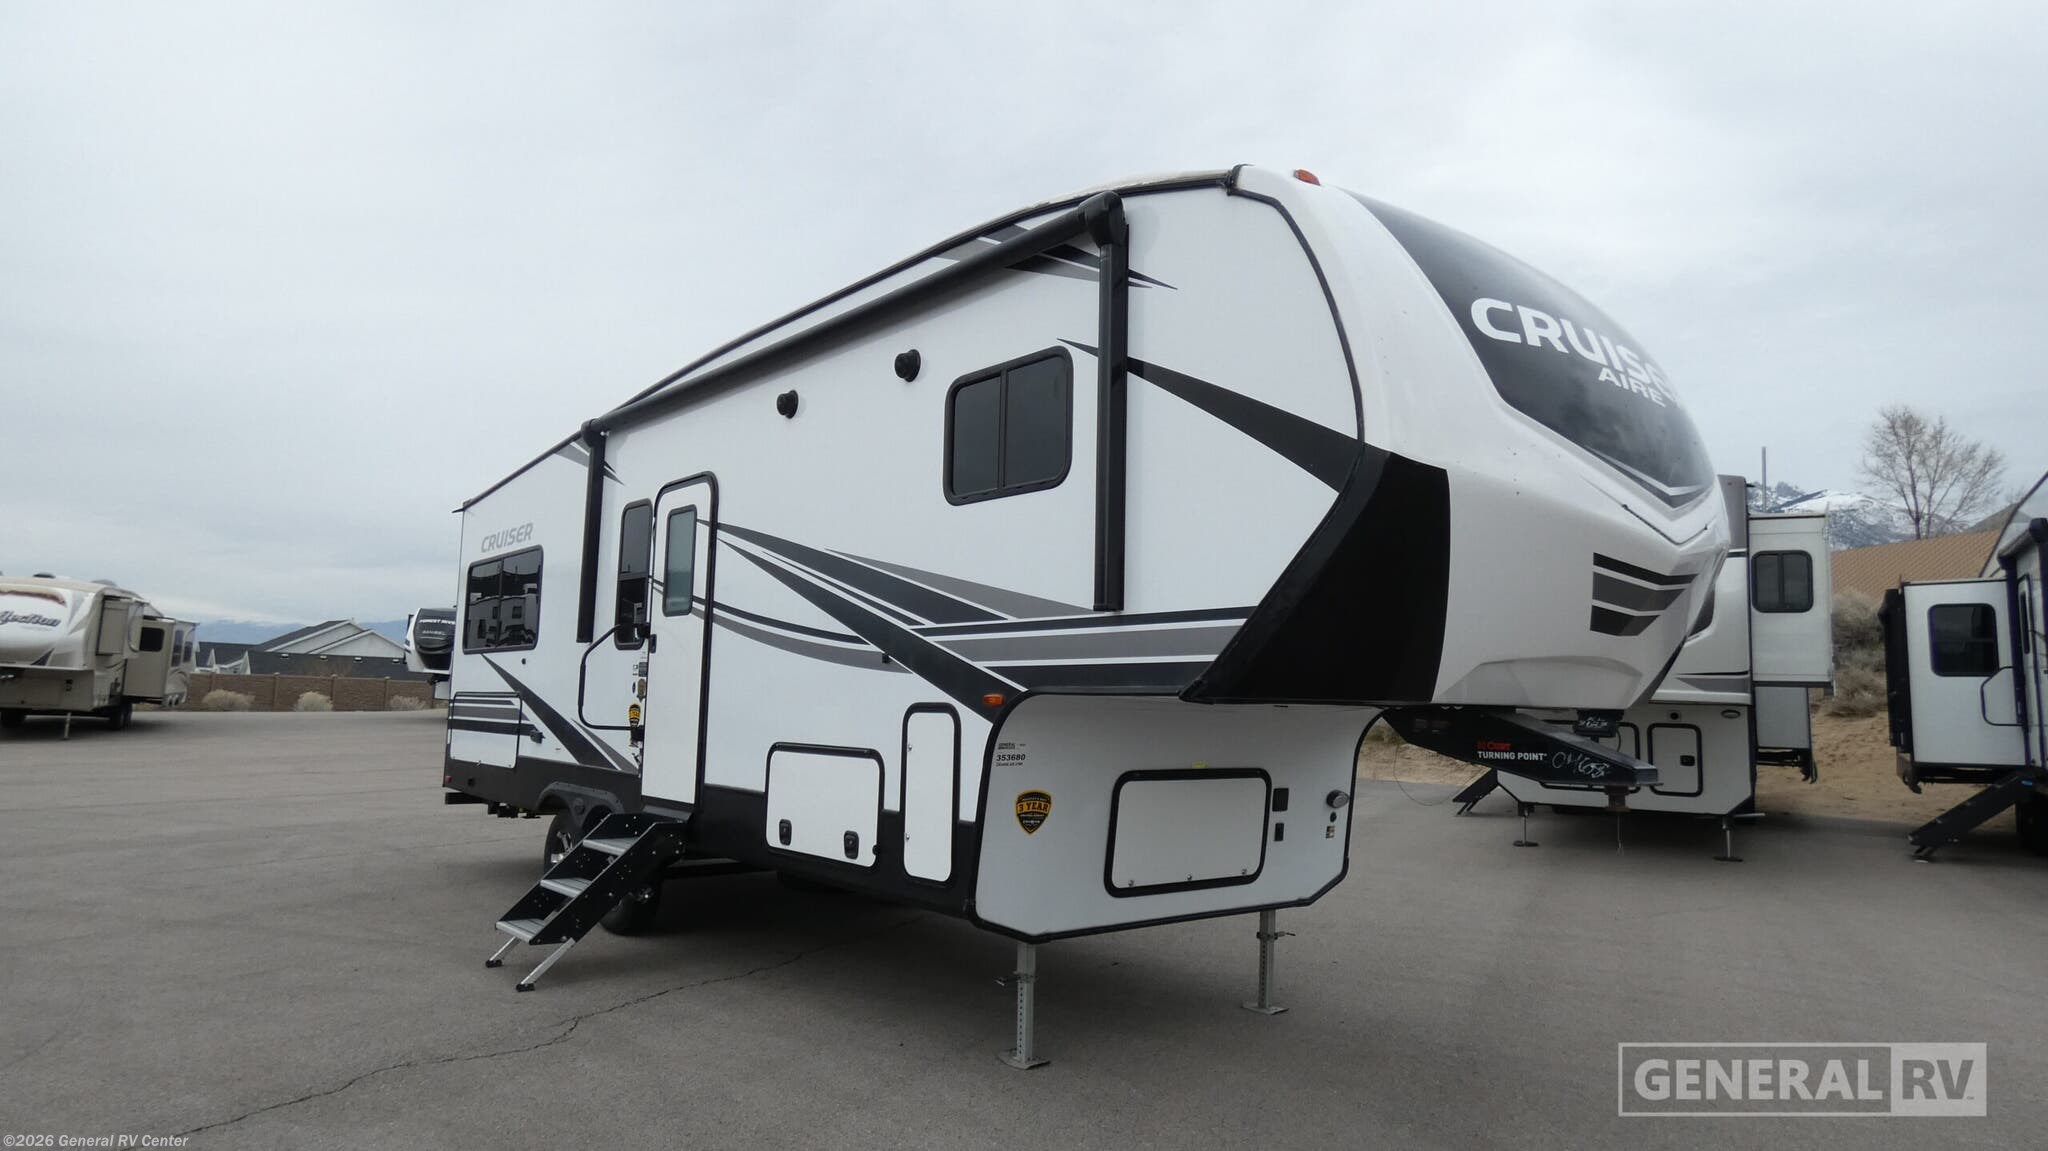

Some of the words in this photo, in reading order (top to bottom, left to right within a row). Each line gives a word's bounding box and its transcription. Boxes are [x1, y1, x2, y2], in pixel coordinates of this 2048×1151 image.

[1599, 367, 1667, 408] AIRE
[481, 522, 533, 552] CRUISER
[996, 753, 1026, 762] 353680
[1477, 751, 1516, 760] TURNING
[1018, 804, 1024, 812] 3
[1026, 801, 1049, 812] YEAR
